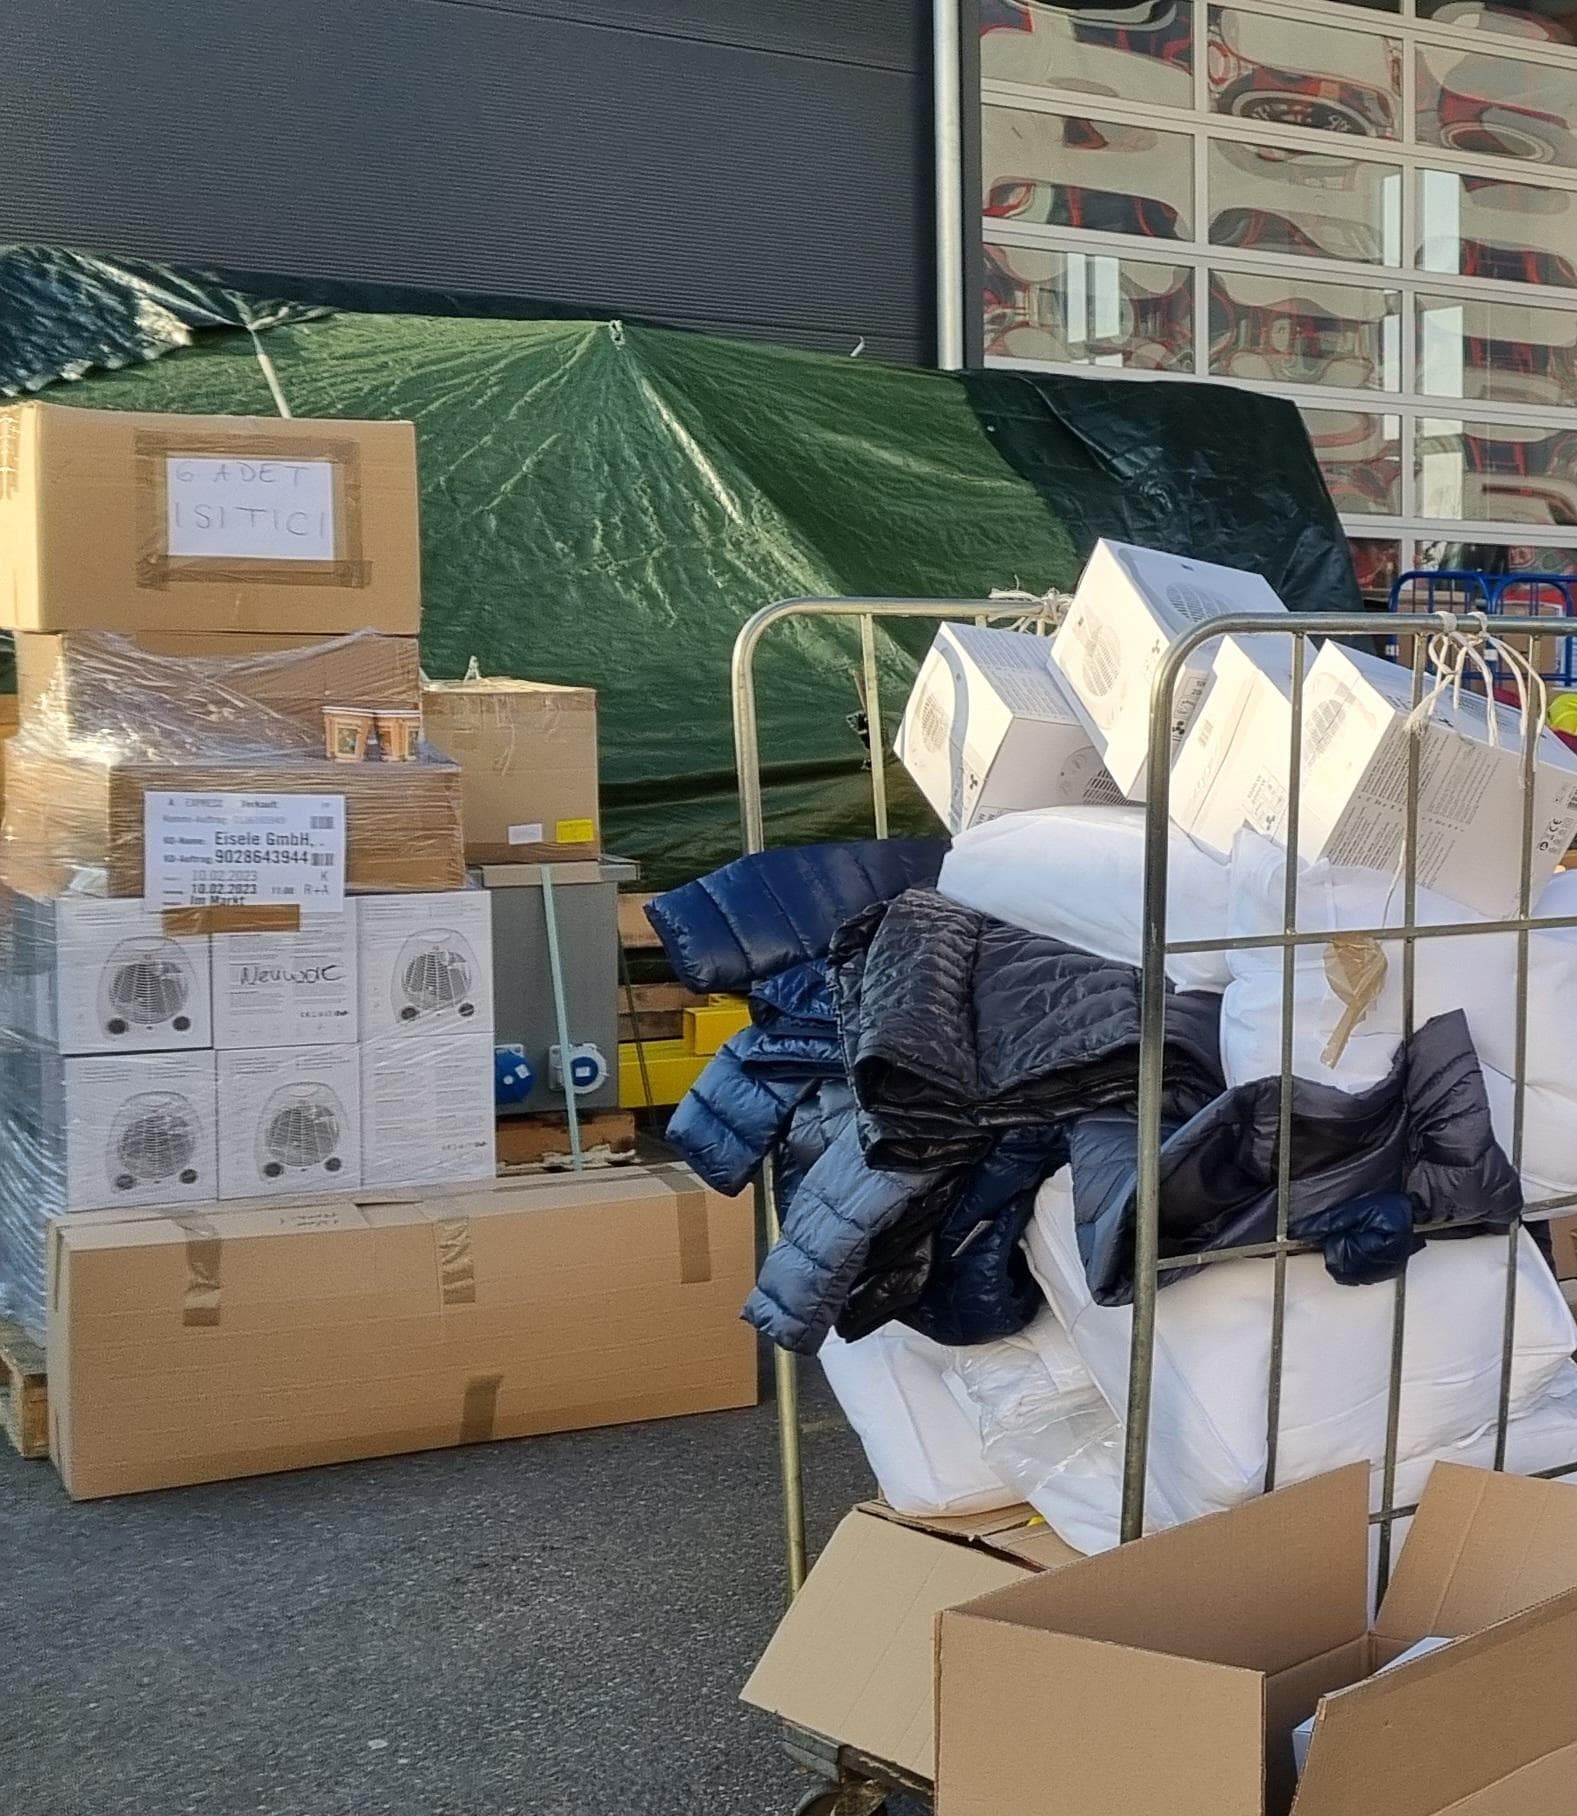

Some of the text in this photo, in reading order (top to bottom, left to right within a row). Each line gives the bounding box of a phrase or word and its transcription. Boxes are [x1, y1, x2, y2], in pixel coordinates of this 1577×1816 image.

[175, 460, 310, 487] 6 ADET
[215, 831, 260, 846] Eisele
[215, 850, 308, 864] 9028643944
[191, 883, 258, 895] 10.02.2023
